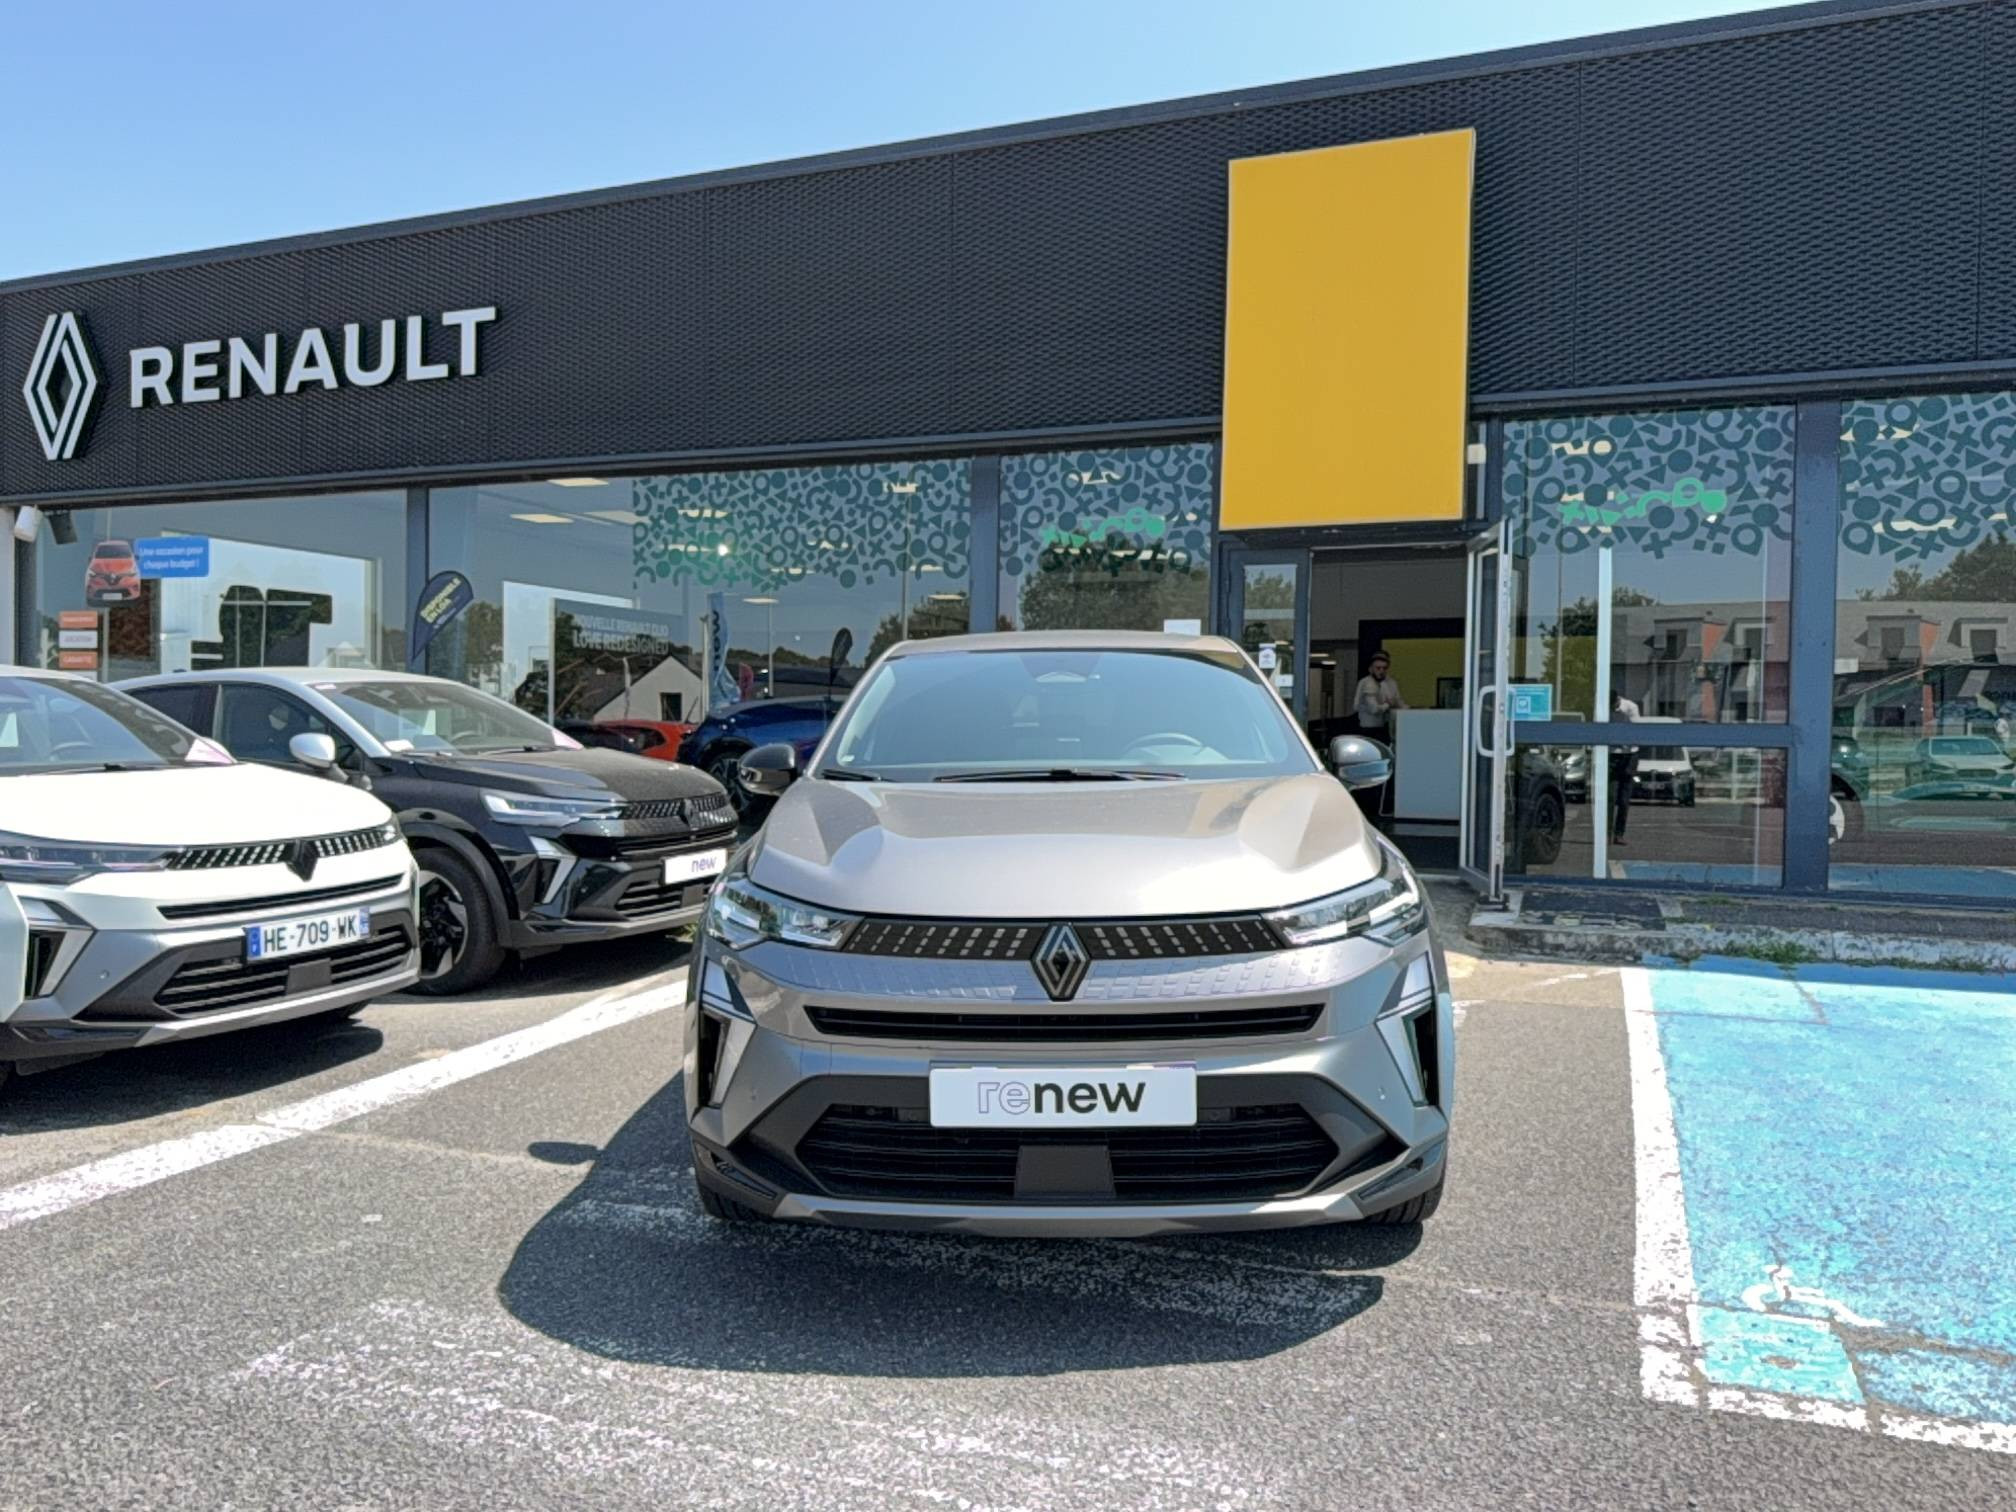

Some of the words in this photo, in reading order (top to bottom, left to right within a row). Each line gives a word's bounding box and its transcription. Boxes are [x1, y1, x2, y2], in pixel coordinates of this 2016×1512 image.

[130, 306, 496, 408] RENAULT
[264, 914, 357, 953] HE-709-WK
[978, 1081, 1146, 1115] renew
